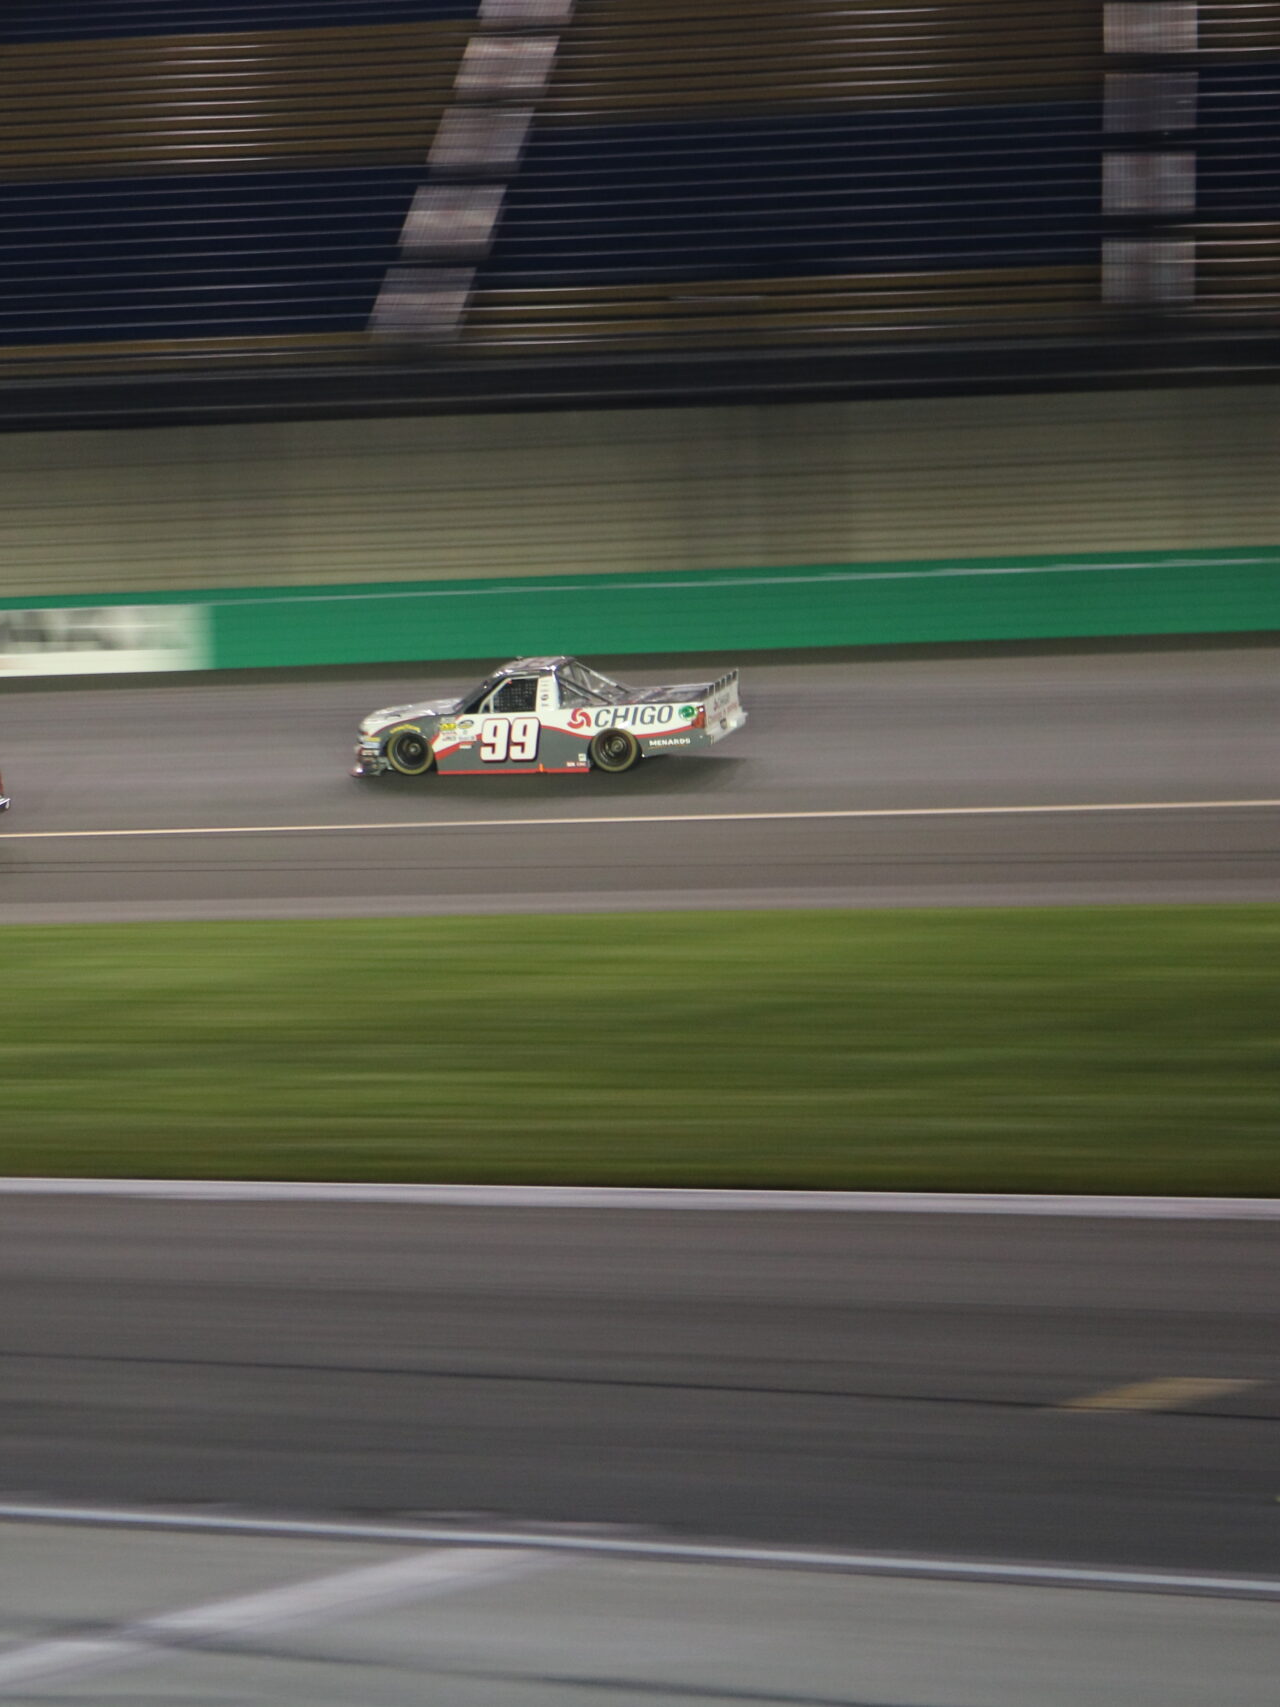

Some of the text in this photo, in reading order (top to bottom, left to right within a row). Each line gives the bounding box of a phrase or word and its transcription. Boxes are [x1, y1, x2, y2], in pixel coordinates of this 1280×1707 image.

[594, 705, 674, 729] CHIGO
[480, 716, 540, 762] 99
[649, 738, 691, 747] MENARDS
